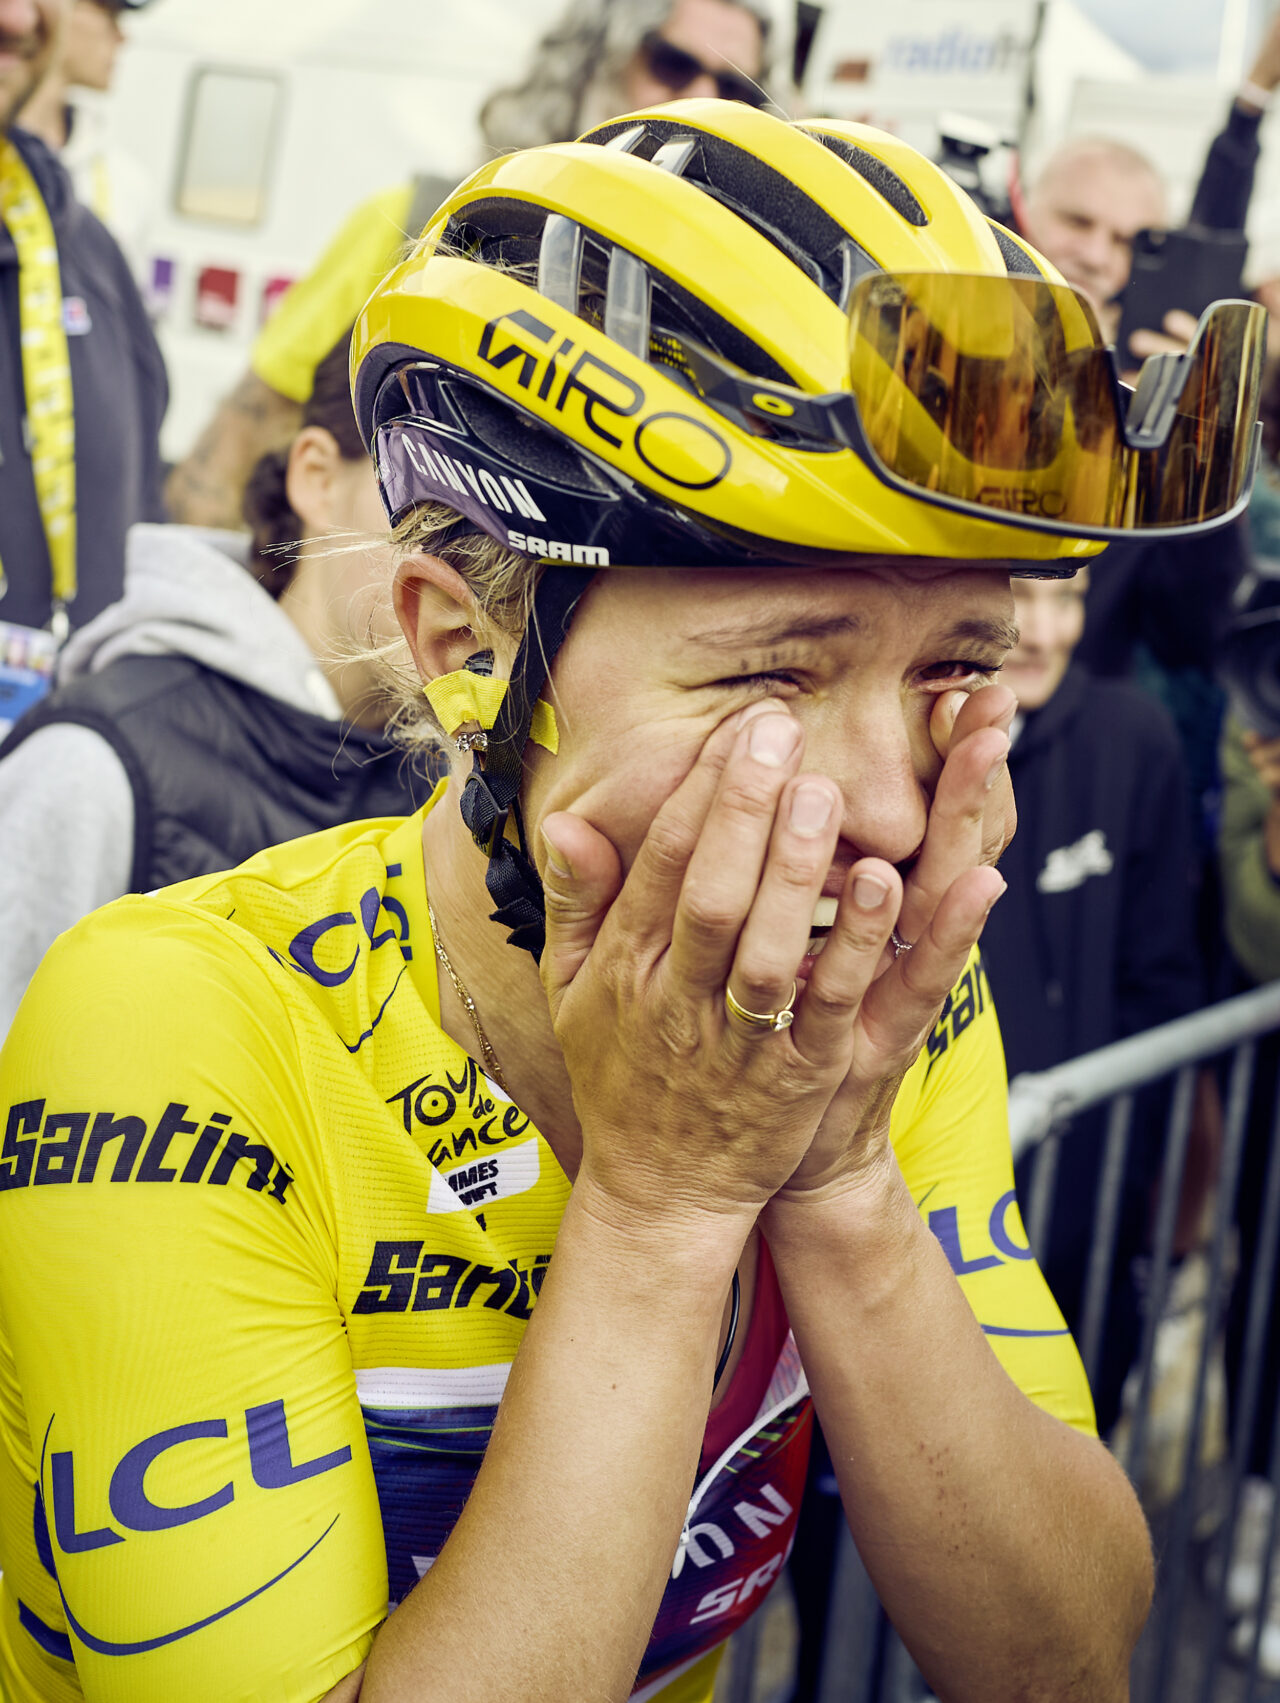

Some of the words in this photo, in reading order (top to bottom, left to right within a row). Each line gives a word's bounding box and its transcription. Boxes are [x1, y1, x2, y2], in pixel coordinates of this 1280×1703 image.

[477, 309, 732, 490] GIRO
[401, 433, 547, 523] CANYON
[507, 529, 610, 567] SRAM
[386, 1056, 493, 1136] Tour
[472, 1094, 495, 1119] de
[426, 1105, 531, 1168] ance
[51, 1398, 352, 1554] LCL
